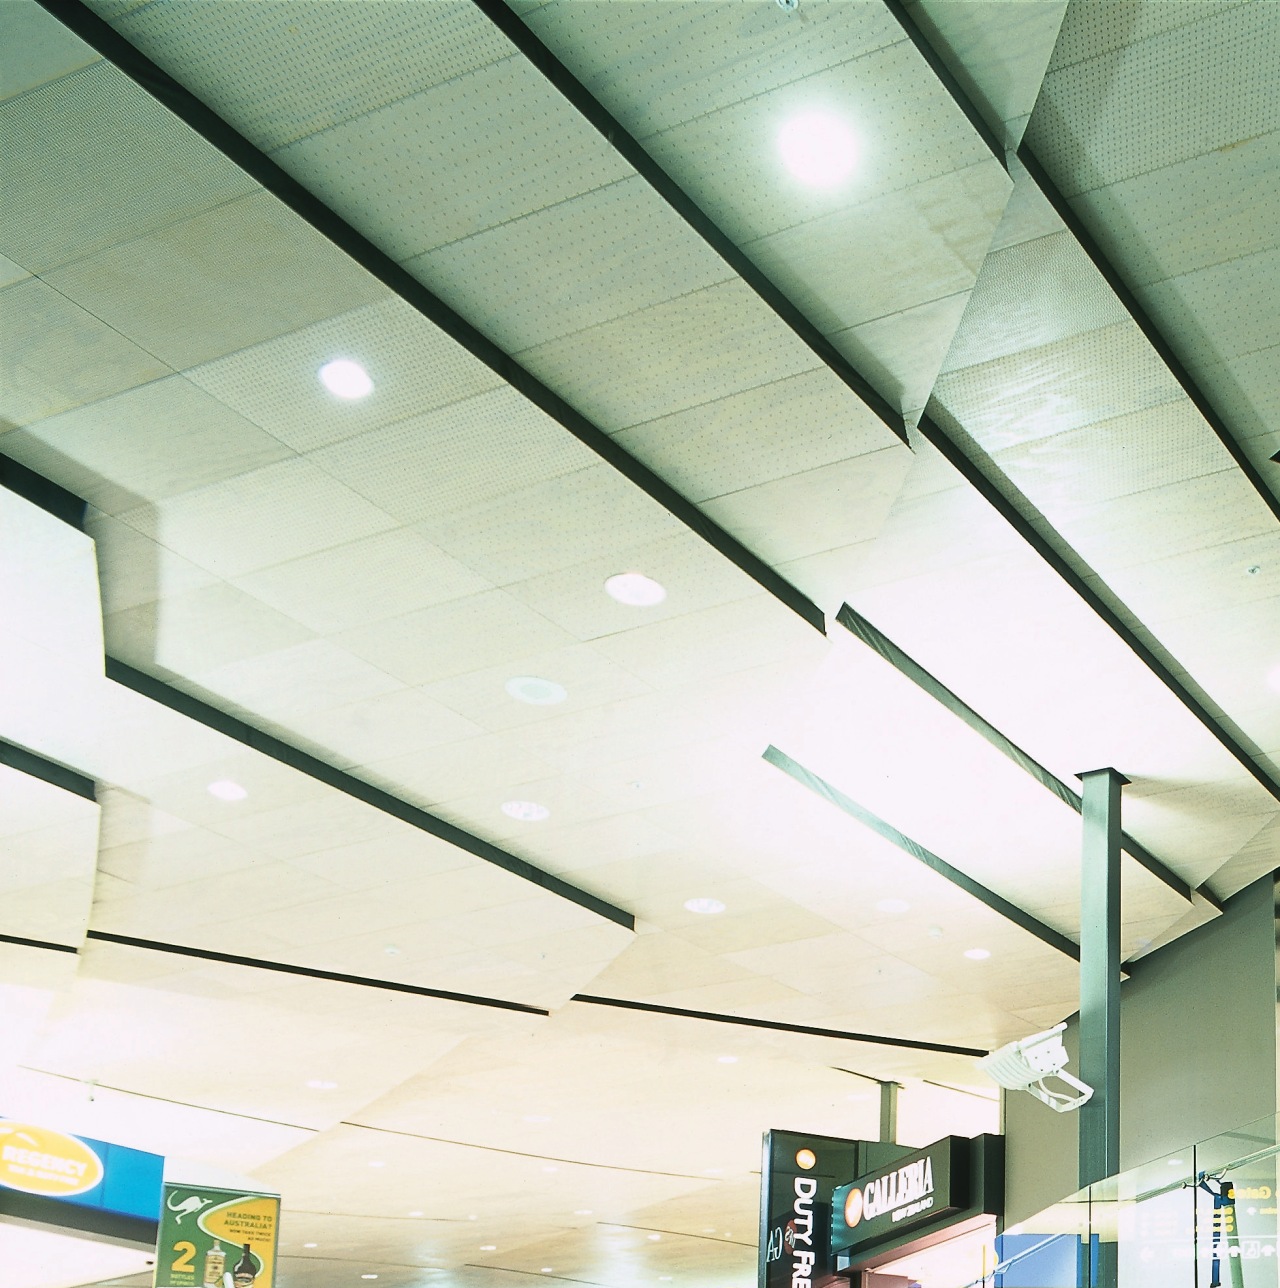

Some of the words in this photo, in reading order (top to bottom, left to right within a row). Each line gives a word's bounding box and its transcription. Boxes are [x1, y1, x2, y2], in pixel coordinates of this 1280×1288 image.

[2, 1145, 88, 1177] REGENCY
[224, 1220, 272, 1229] AUSTRALIA?
[227, 1212, 260, 1221] HEADING
[794, 1177, 817, 1245] DUTY
[171, 1241, 196, 1273] 2
